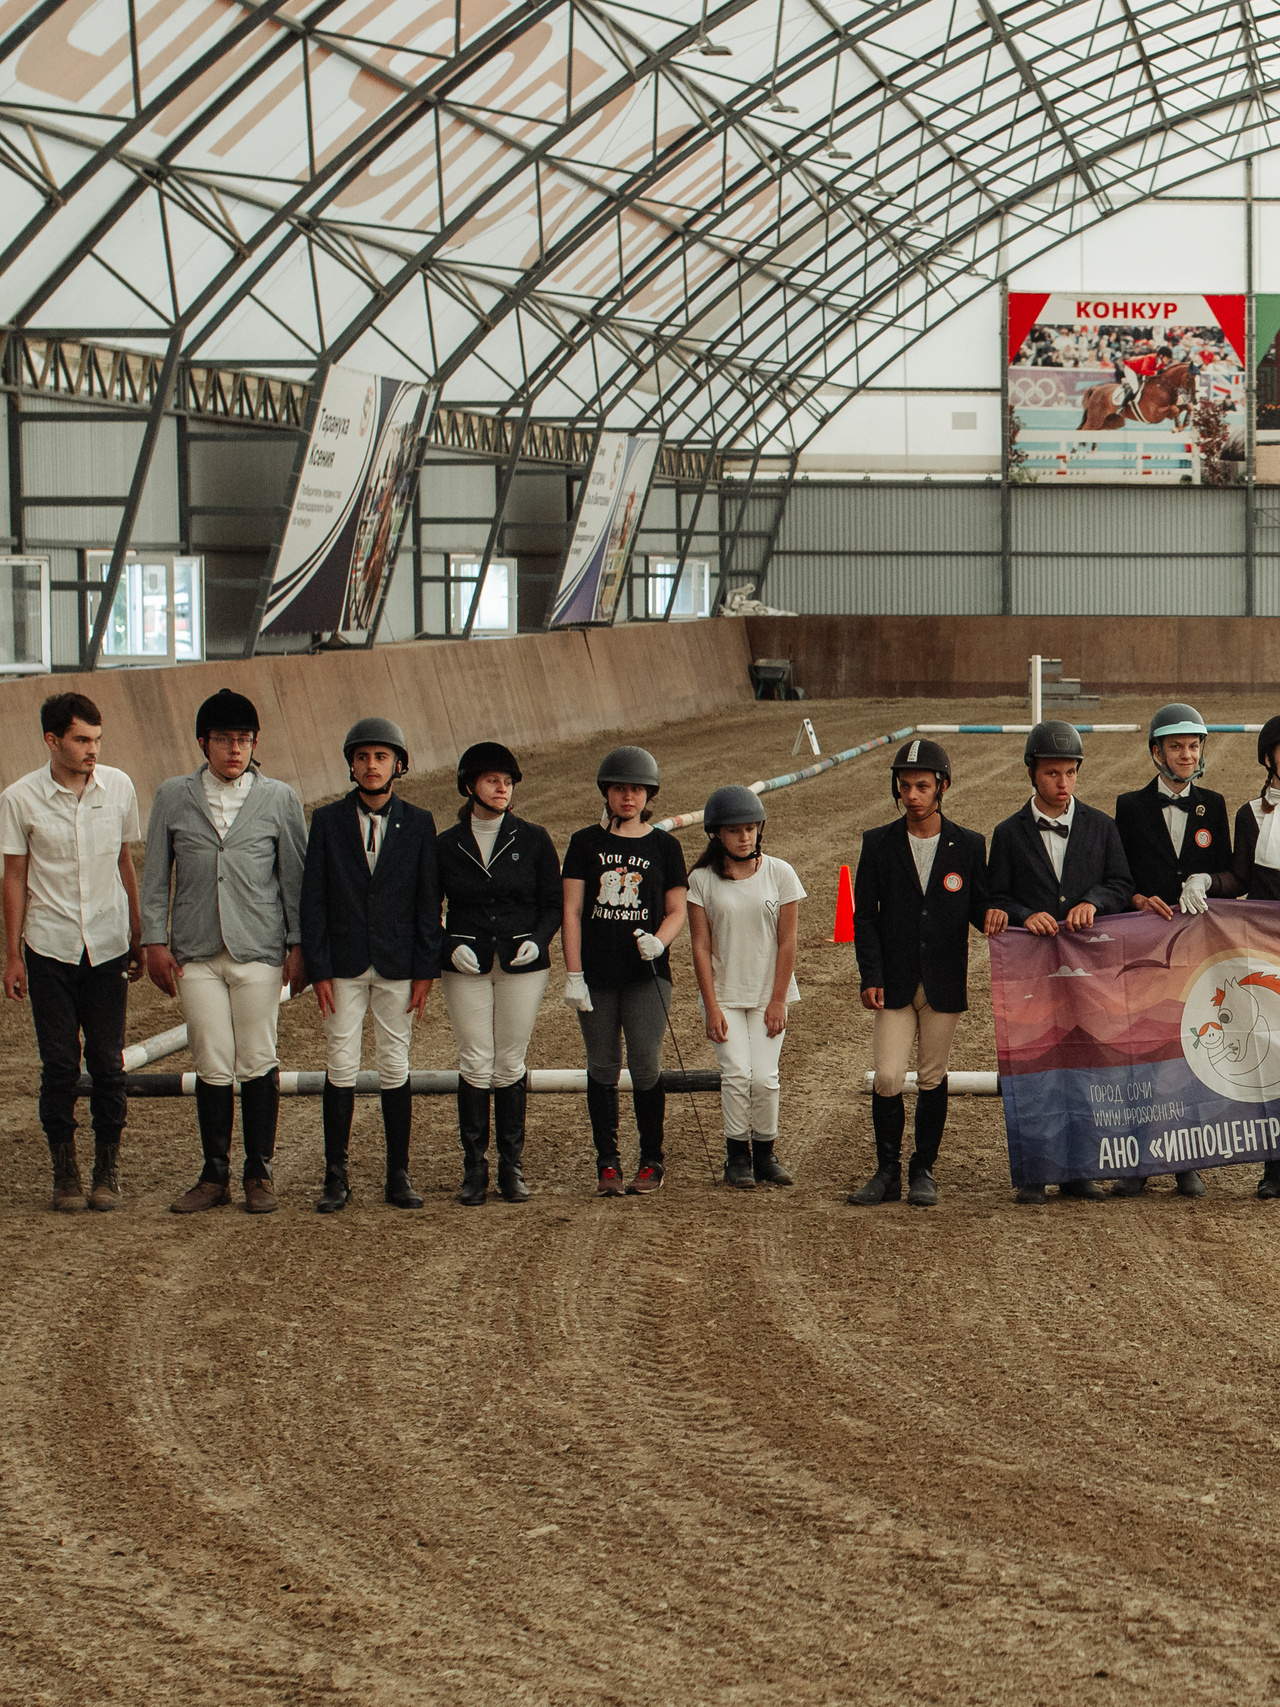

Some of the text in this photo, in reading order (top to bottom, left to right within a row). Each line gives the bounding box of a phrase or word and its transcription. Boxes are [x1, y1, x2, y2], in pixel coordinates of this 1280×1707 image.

[1076, 302, 1178, 319] КОНКУР
[308, 444, 335, 468] Ксения
[598, 852, 650, 869] You are
[1090, 1081, 1153, 1104] ГОРОД СОЧИ
[1093, 1100, 1185, 1127] WWW.IPPOSOCHI.RU
[1099, 1135, 1139, 1170] АНО
[1149, 1116, 1280, 1163] «ИППОЦЕНТР
